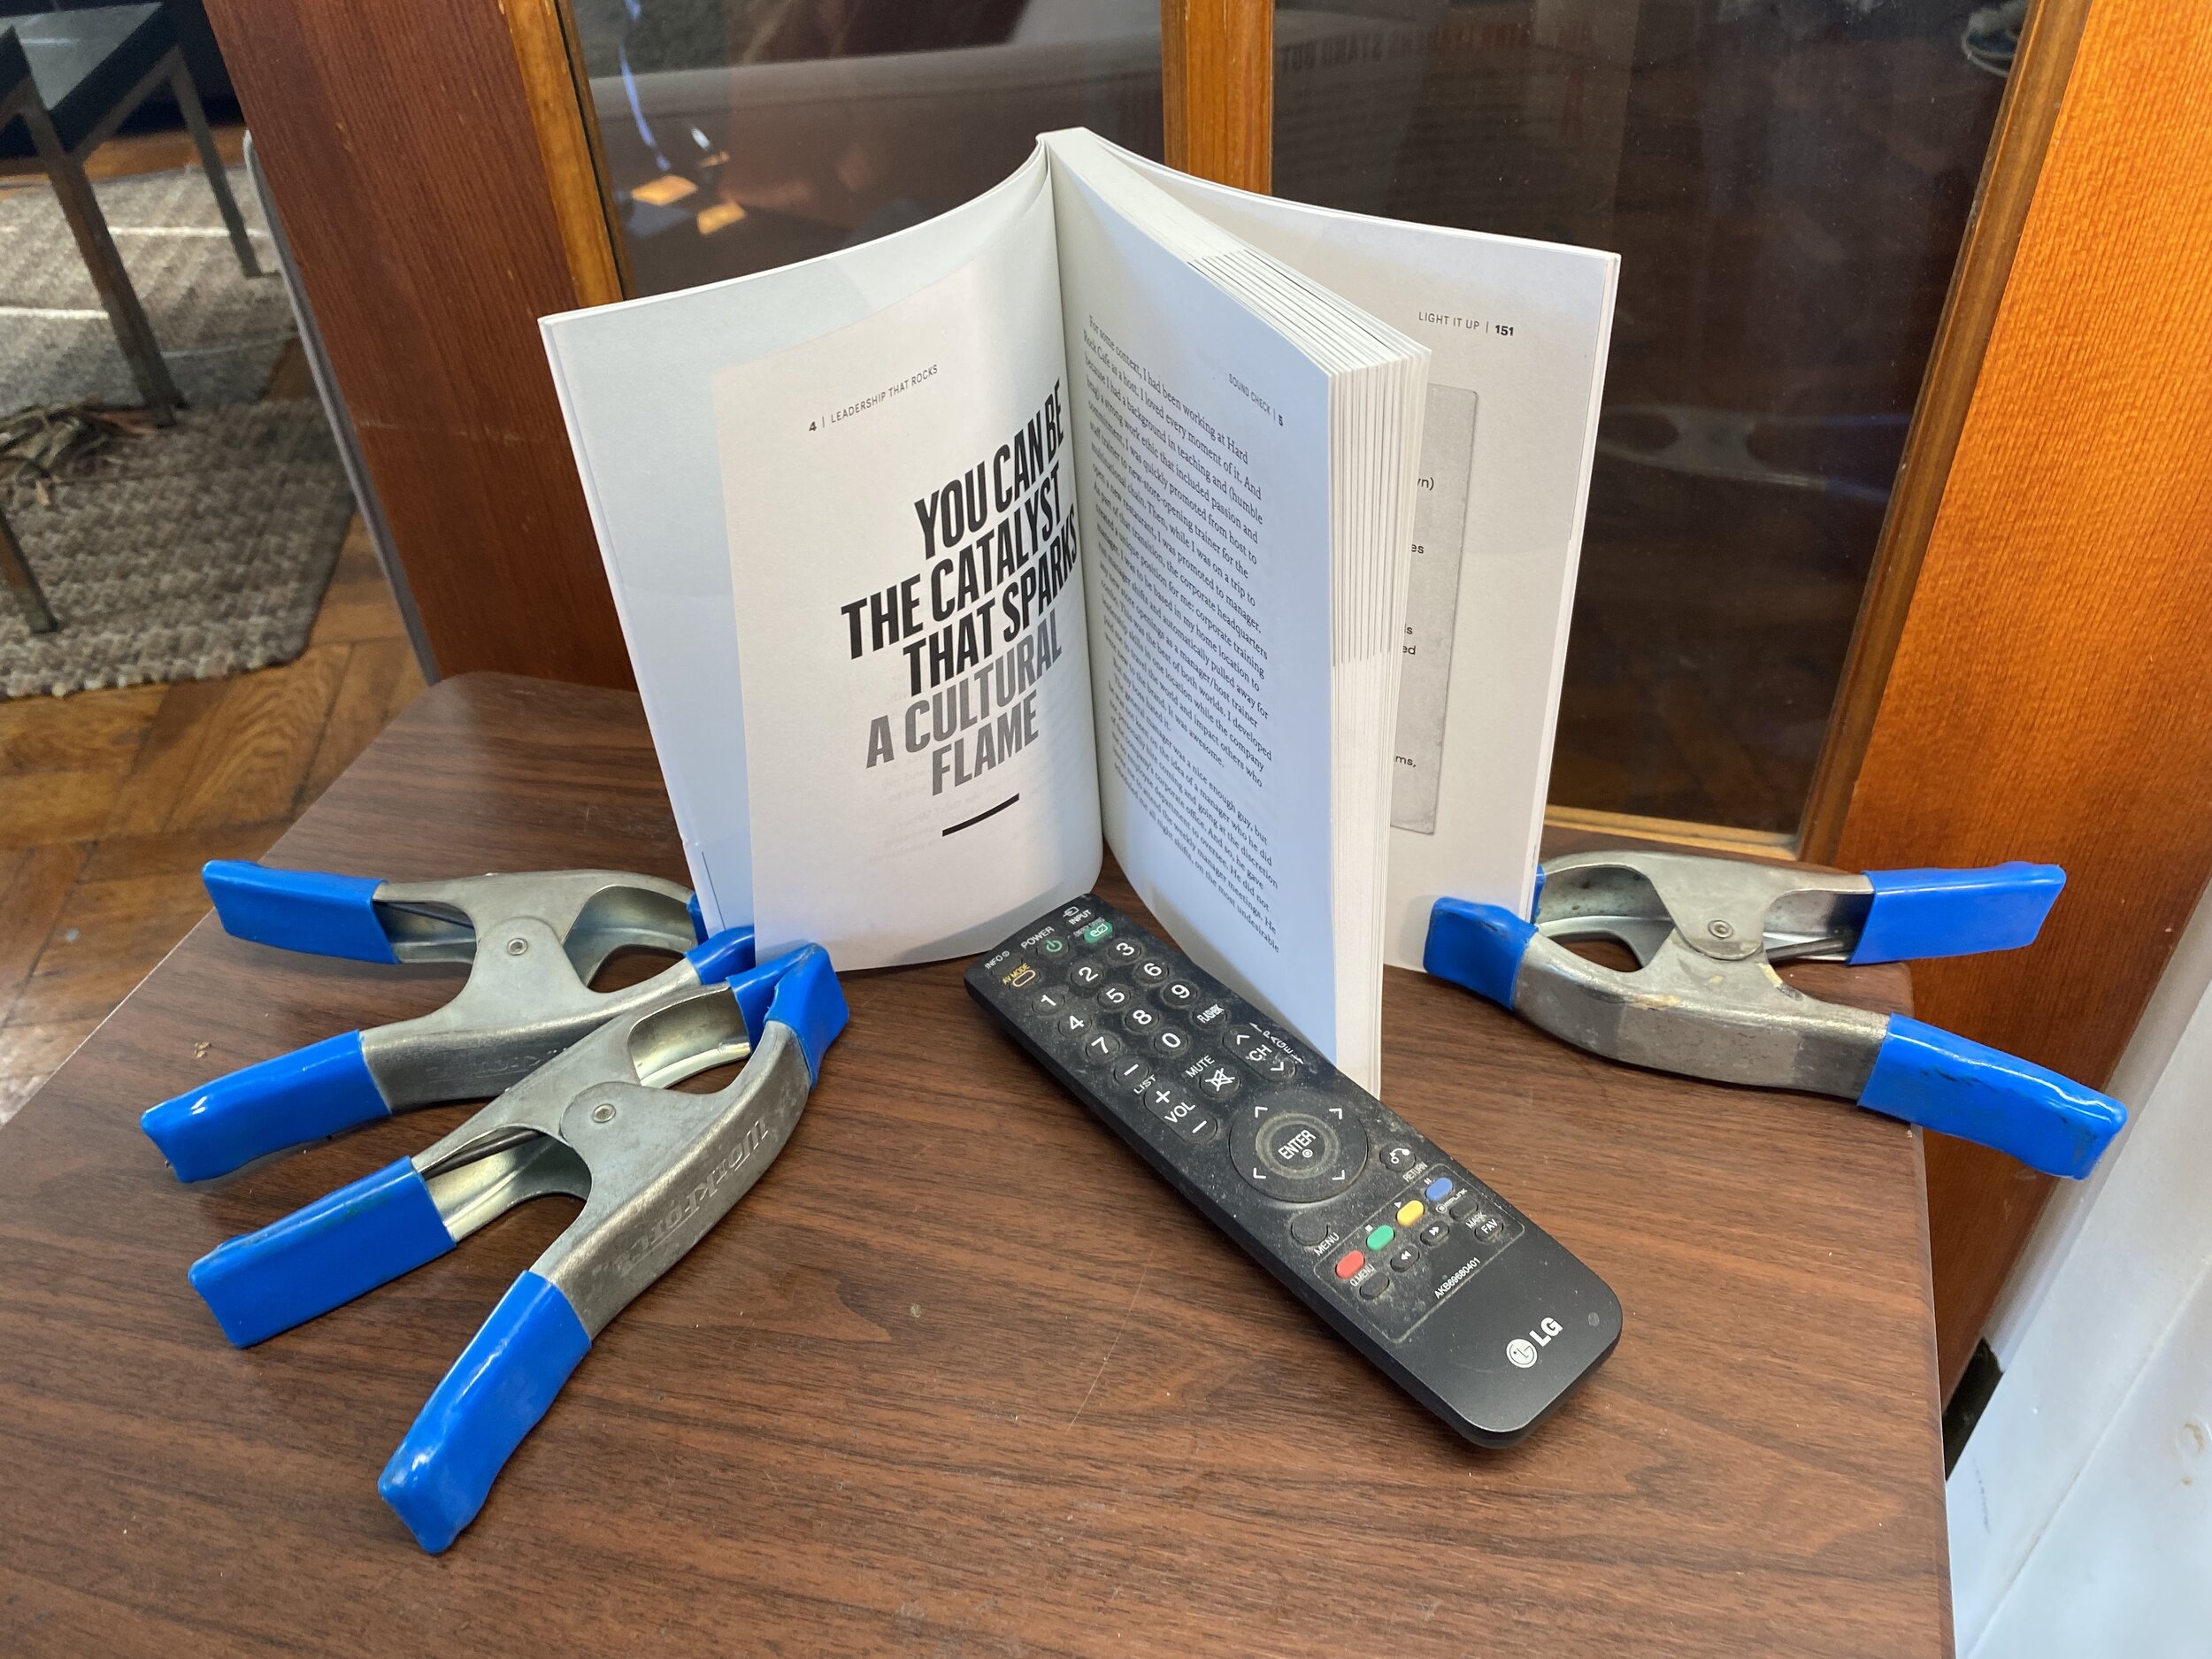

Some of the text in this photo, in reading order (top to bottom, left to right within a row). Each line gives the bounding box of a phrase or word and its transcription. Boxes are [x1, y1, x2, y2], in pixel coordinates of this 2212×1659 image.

[1418, 311, 1514, 336] LIGHT IT UP 151
[807, 365, 939, 432] 4 LEADERSHIP THAT ROCKS
[1162, 383, 1248, 465] been working at Hard
[1228, 373, 1285, 427] SOUND CHECK 5
[913, 377, 1064, 561] YOU CAN BE
[1165, 414, 1262, 500] every moment of it. And
[1167, 434, 1263, 524] in teaching and (humble
[1169, 483, 1257, 565] promoted from host to
[1175, 464, 1258, 544] included passion and
[841, 460, 1061, 660] THE CATALYST
[1169, 524, 1256, 606] while I was on a trip to
[1194, 524, 1248, 579] trainer for the
[902, 503, 1078, 697] THAT SPARKS
[1177, 551, 1261, 633] promoted to manager.
[1179, 574, 1268, 659] corporate headquarters
[1168, 580, 1264, 680] for me: corporate training
[1173, 604, 1260, 692] in my home location to
[865, 608, 1063, 769] A CULTURAL
[1163, 615, 1269, 719] automatically pulled away for
[1179, 649, 1258, 727] manager/host trainer
[1165, 668, 1264, 772] location while the company
[1174, 714, 1224, 767] was awesome.
[1180, 665, 1271, 761] both worlds. I developed
[932, 688, 1040, 796] FLAME
[1179, 703, 1263, 787] and impact others who
[1186, 774, 1272, 866] of manager who he did
[1192, 764, 1267, 845] nice enough guy, but
[1184, 788, 1278, 888] and going at the discretion
[1186, 806, 1263, 889] office. And so, he gave
[1173, 823, 1276, 934] weekly manager meetings. He
[1192, 826, 1269, 911] to oversee. He did not
[1068, 909, 1092, 926] INPUT
[1194, 860, 1279, 952] on the most undesirable
[1020, 926, 1056, 949] POWER
[1116, 942, 1135, 956] 3
[1002, 962, 1031, 986] AV MODE
[1078, 966, 1099, 982] 2
[1106, 987, 1125, 1003] 5
[1143, 963, 1162, 977] 6
[1171, 984, 1191, 1000] 9
[1040, 994, 1057, 1008] 1
[1068, 1015, 1086, 1031] 4
[1133, 1009, 1153, 1025] 8
[1090, 1036, 1110, 1054] 7
[1162, 1033, 1181, 1048] 0
[1185, 1055, 1215, 1078] MUTE
[1248, 1044, 1272, 1062] CH
[1263, 1031, 1294, 1054] PAGE
[1133, 1074, 1156, 1094] LIST
[1164, 1102, 1196, 1124] VOL
[1278, 1129, 1317, 1161] ENTER
[1402, 1161, 1428, 1183] RETURN
[1313, 1232, 1340, 1256] MENU
[1465, 1211, 1487, 1230] MARK
[1480, 1218, 1498, 1234] FAV
[1433, 1256, 1482, 1300] AKB69680401
[1529, 1317, 1563, 1348] LG
